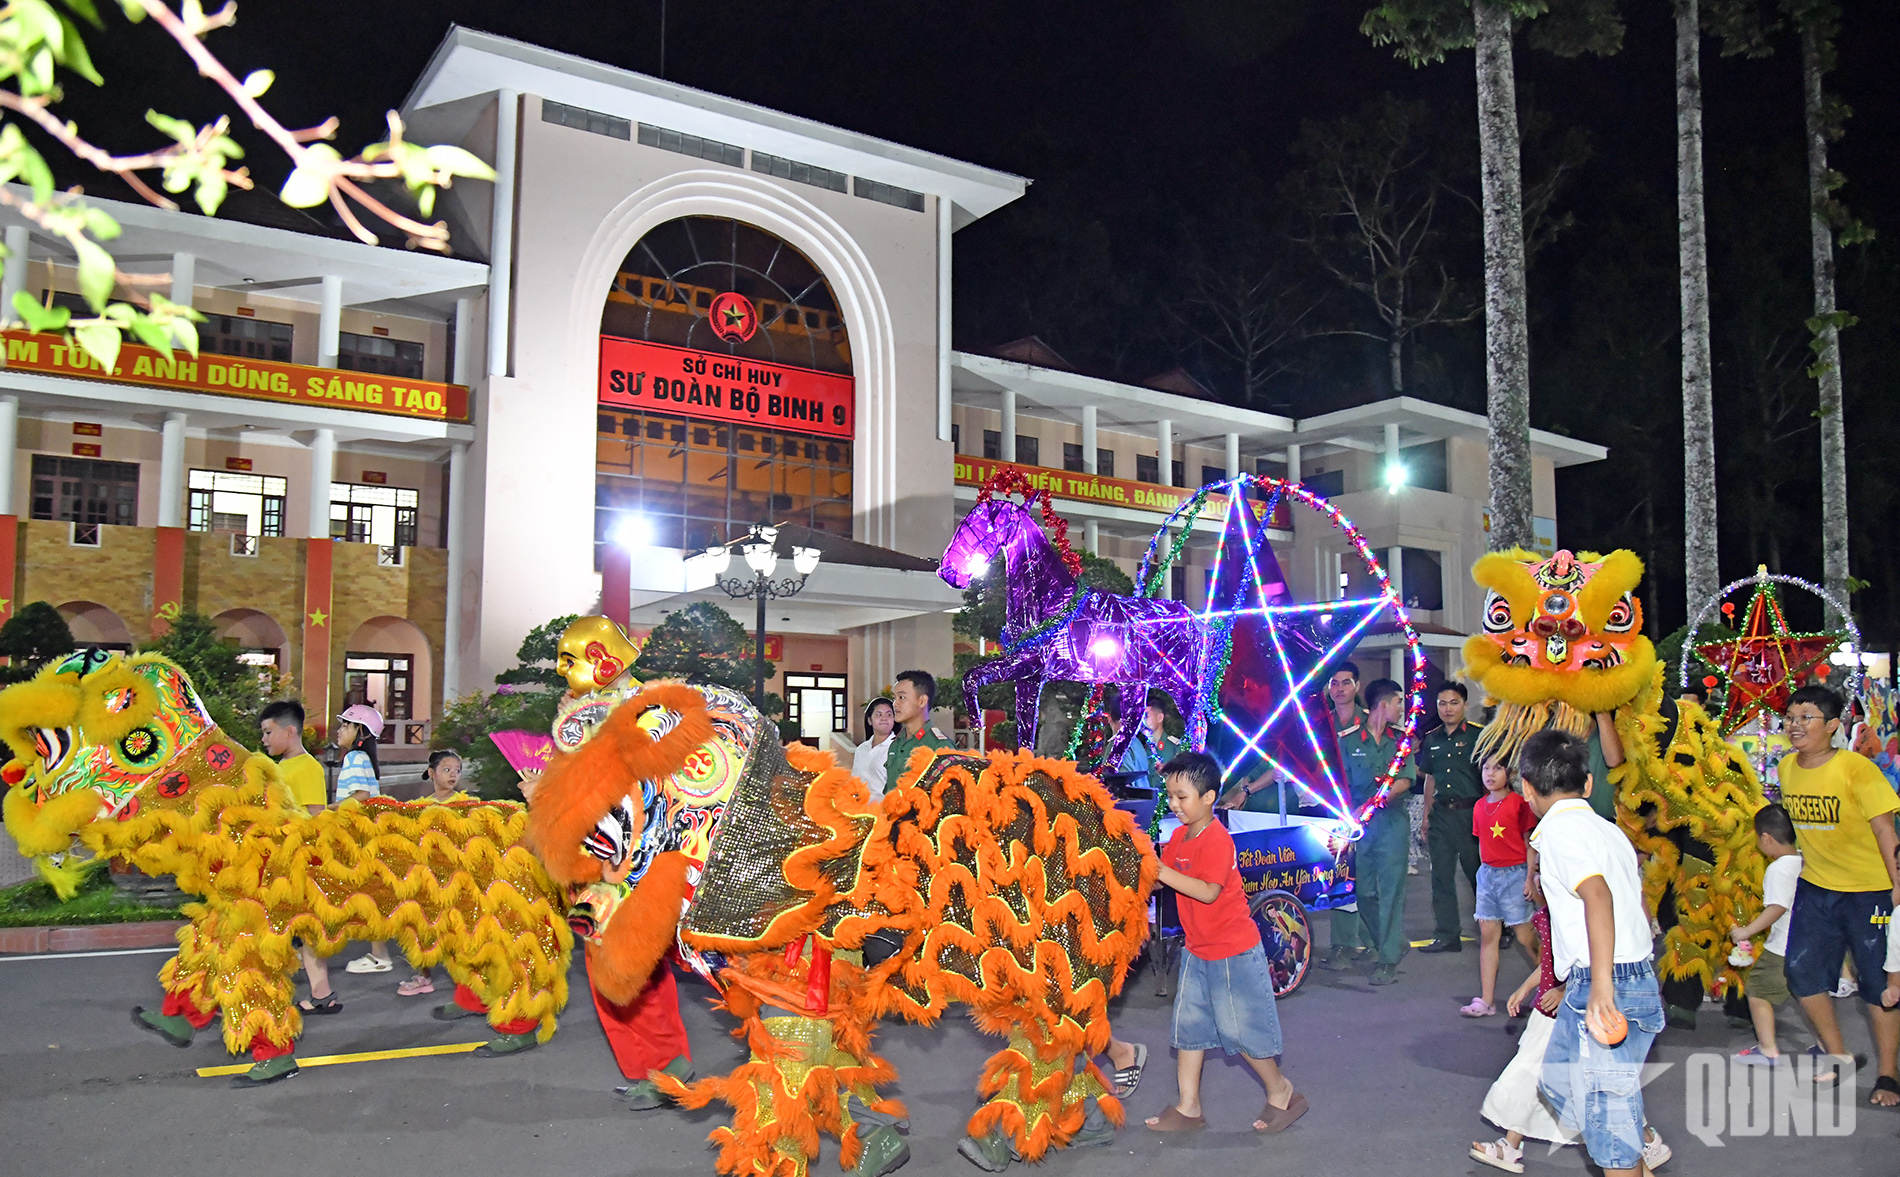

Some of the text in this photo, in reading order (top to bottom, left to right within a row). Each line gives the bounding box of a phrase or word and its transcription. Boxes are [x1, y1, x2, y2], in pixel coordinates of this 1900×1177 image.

[0, 335, 39, 363] M
[132, 355, 198, 382] ANH
[208, 363, 297, 397] DŨNG,
[306, 375, 383, 405] SÁNG
[391, 386, 448, 415] TẠO,
[683, 355, 782, 388] SỞ CHỈ HUY
[610, 370, 846, 426] SƯ ĐOÀN BỘ BINH 9
[1068, 477, 1130, 504] THẮNG,
[1134, 488, 1179, 508] ĐÁNH
[1206, 495, 1229, 517] DỨ
